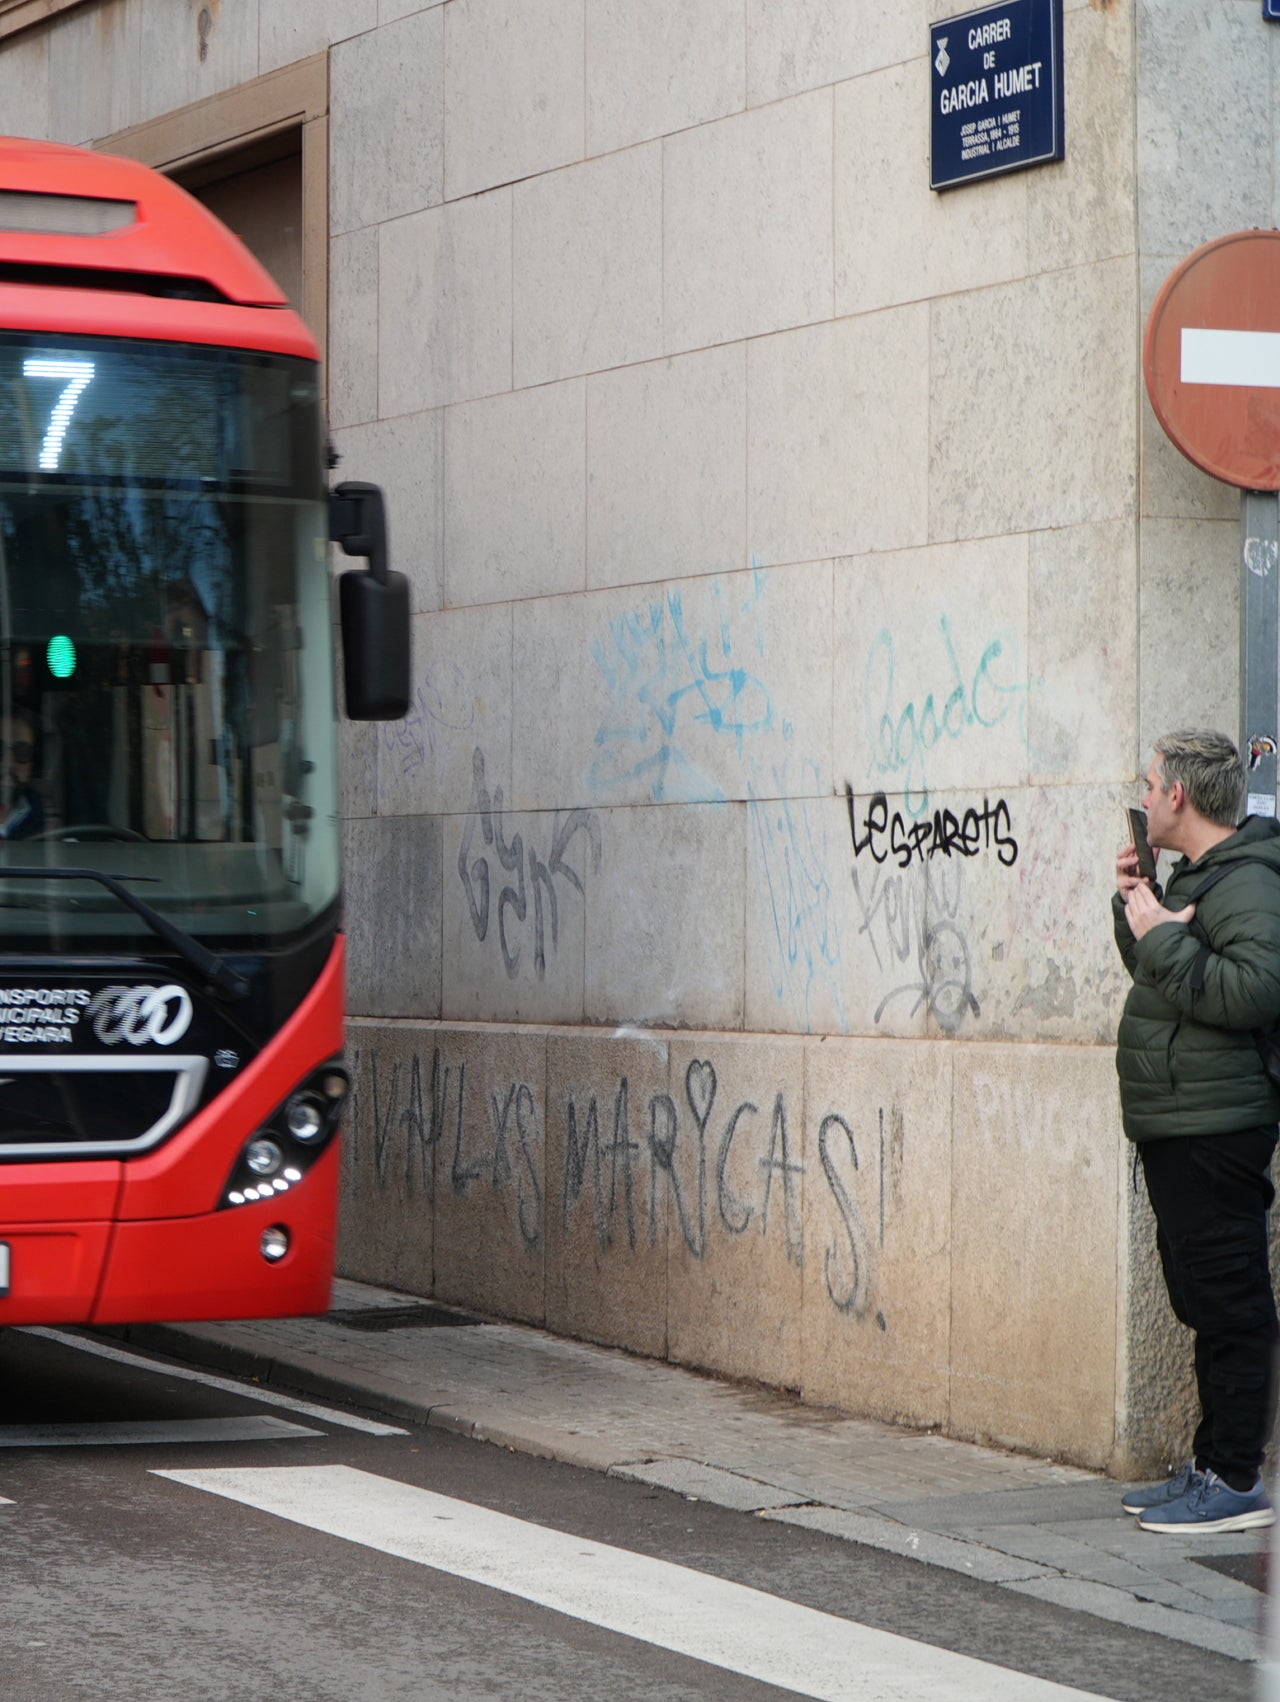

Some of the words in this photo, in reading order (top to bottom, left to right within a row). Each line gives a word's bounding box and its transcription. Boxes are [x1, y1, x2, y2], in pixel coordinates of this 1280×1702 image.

[968, 18, 1011, 50] CARRER
[983, 50, 996, 70] DE
[941, 78, 989, 115] GARCIA
[994, 62, 1042, 99] HUMET
[977, 117, 996, 131] GARCIA
[1002, 110, 1021, 124] HUMET
[996, 135, 1020, 151] ALCALDE
[23, 359, 95, 469] 7
